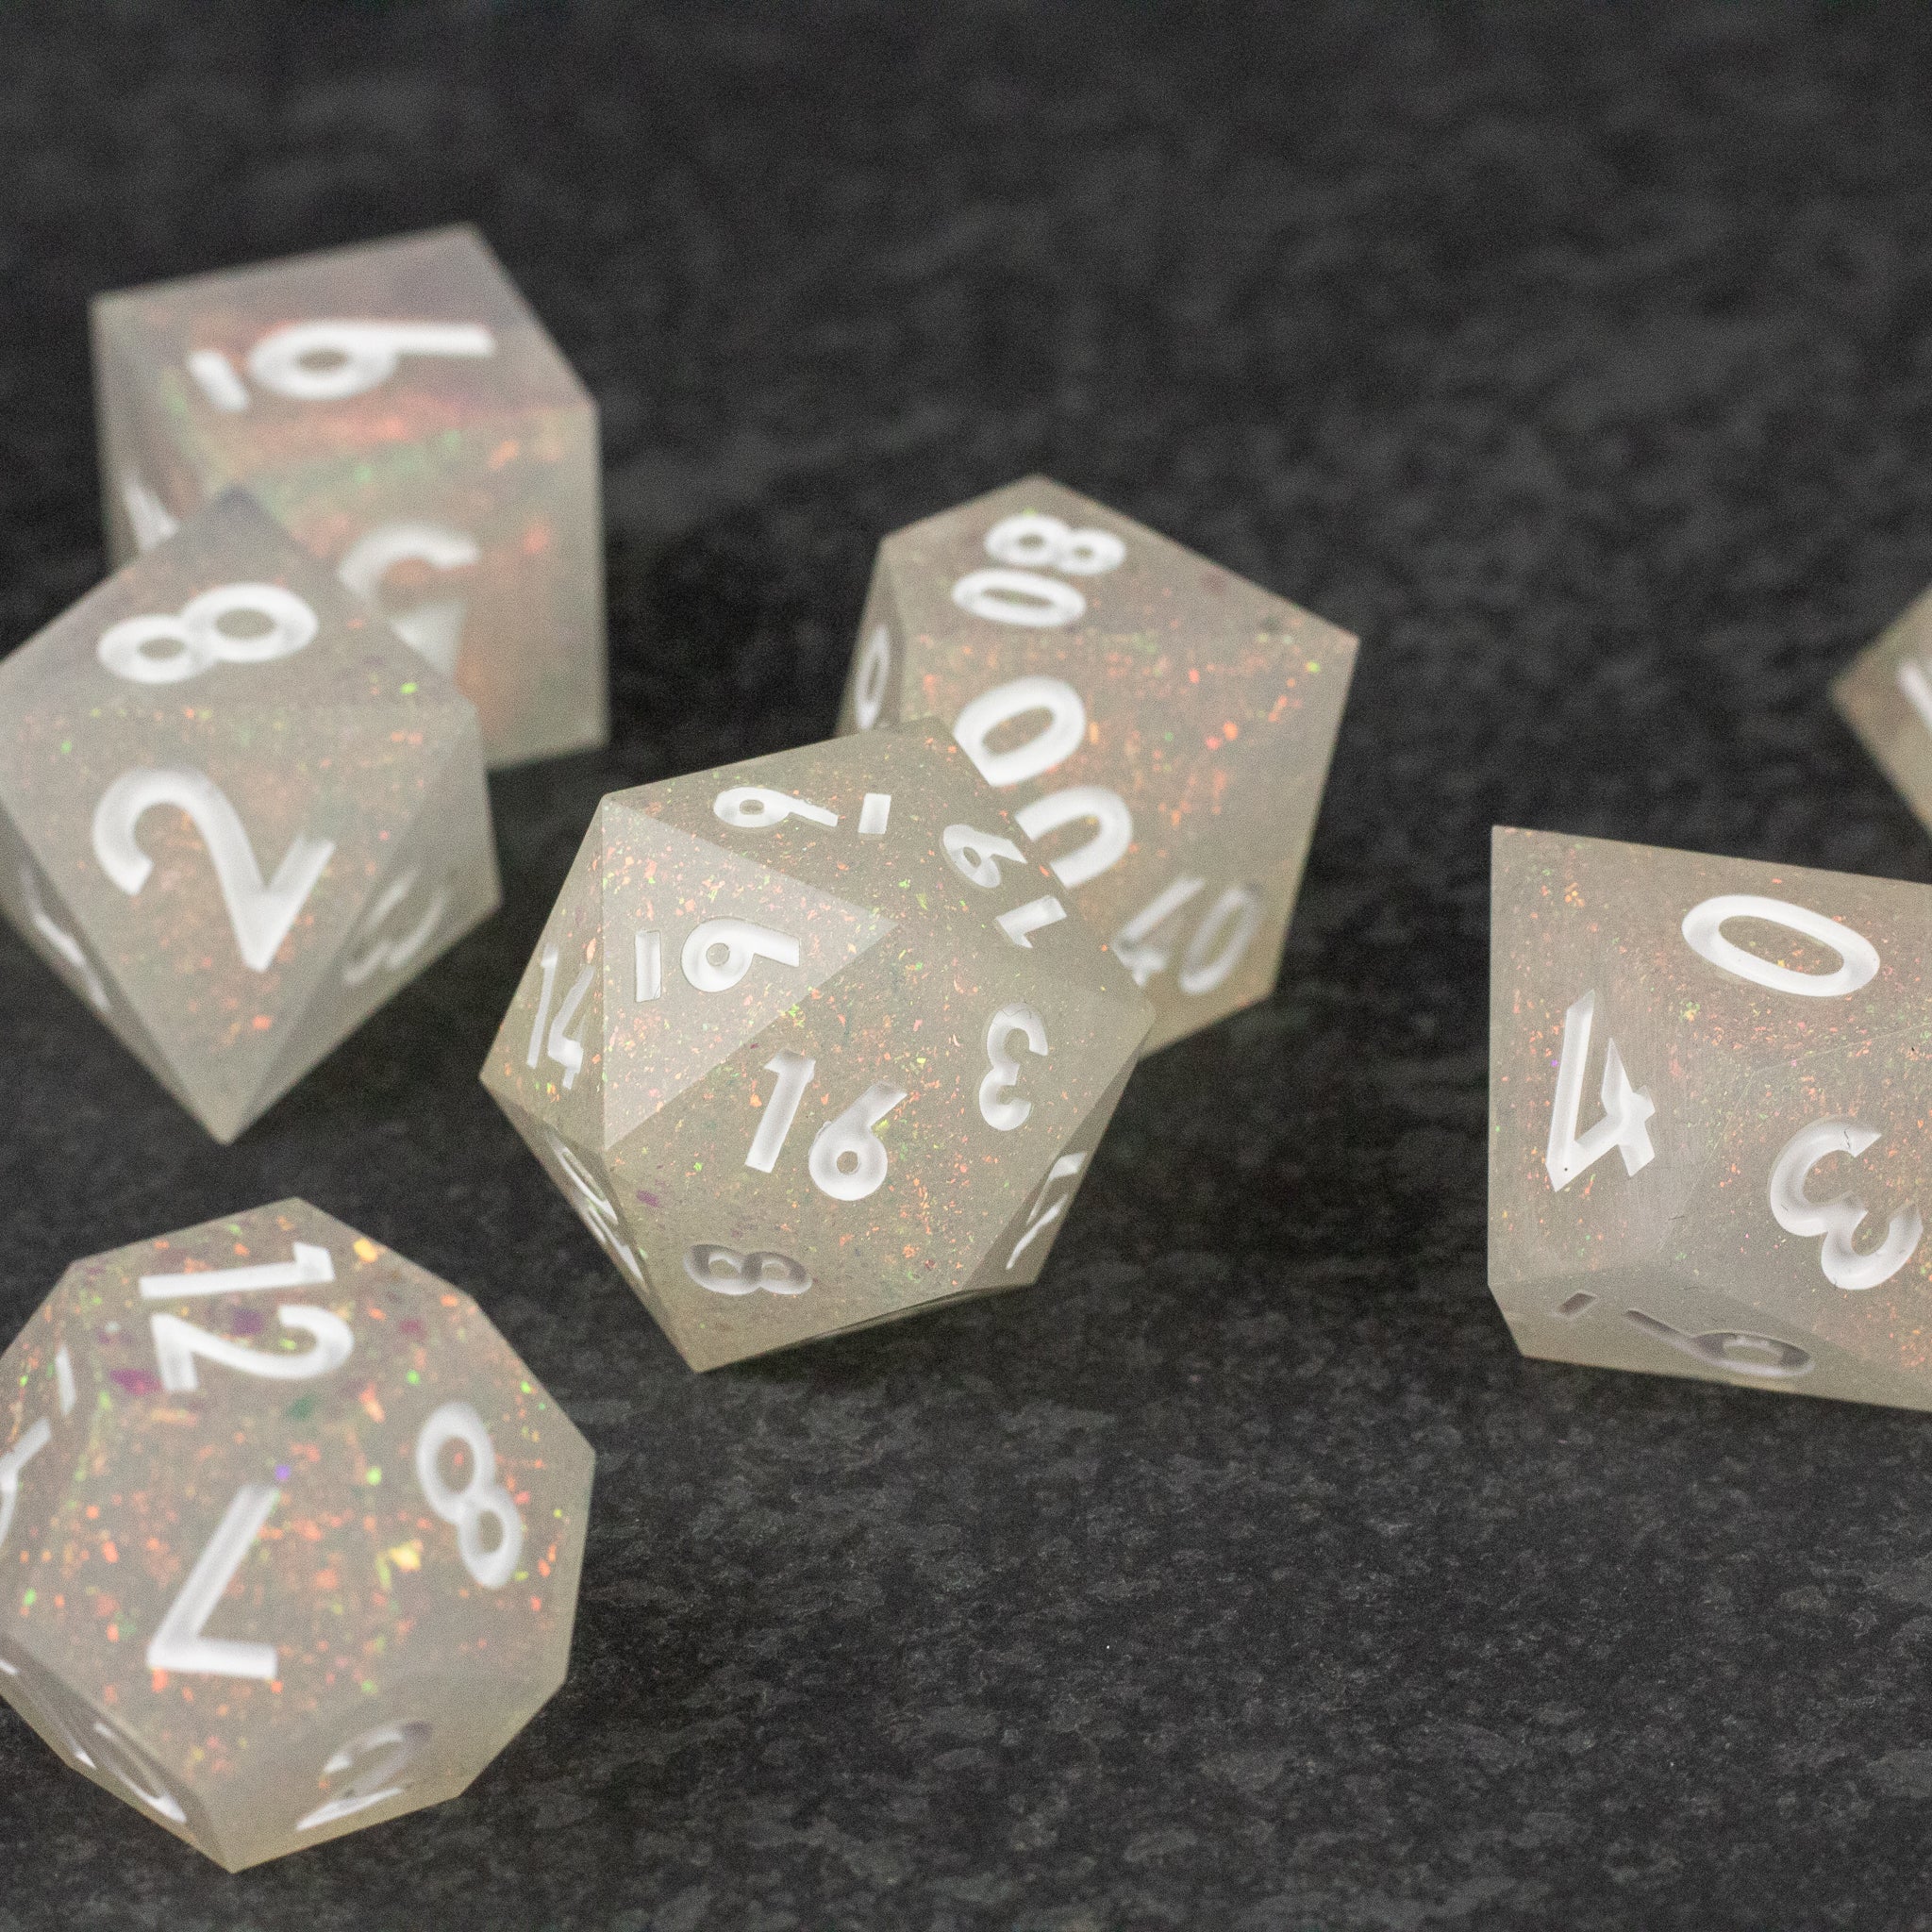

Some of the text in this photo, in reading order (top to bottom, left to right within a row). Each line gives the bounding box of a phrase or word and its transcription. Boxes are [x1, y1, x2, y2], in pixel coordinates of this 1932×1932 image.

[96, 582, 320, 685] 8
[953, 512, 1125, 628] 80
[92, 766, 337, 973] 2
[525, 941, 597, 1091] 14
[1681, 894, 1881, 998] 0
[744, 1049, 908, 1202] 16
[976, 1002, 1049, 1132] 3
[1545, 989, 1657, 1193] 4
[681, 1242, 813, 1297] 8
[1770, 1117, 1924, 1291] 3
[139, 1241, 354, 1392] 12
[416, 1402, 524, 1589] 8
[147, 1483, 281, 1680] 7
